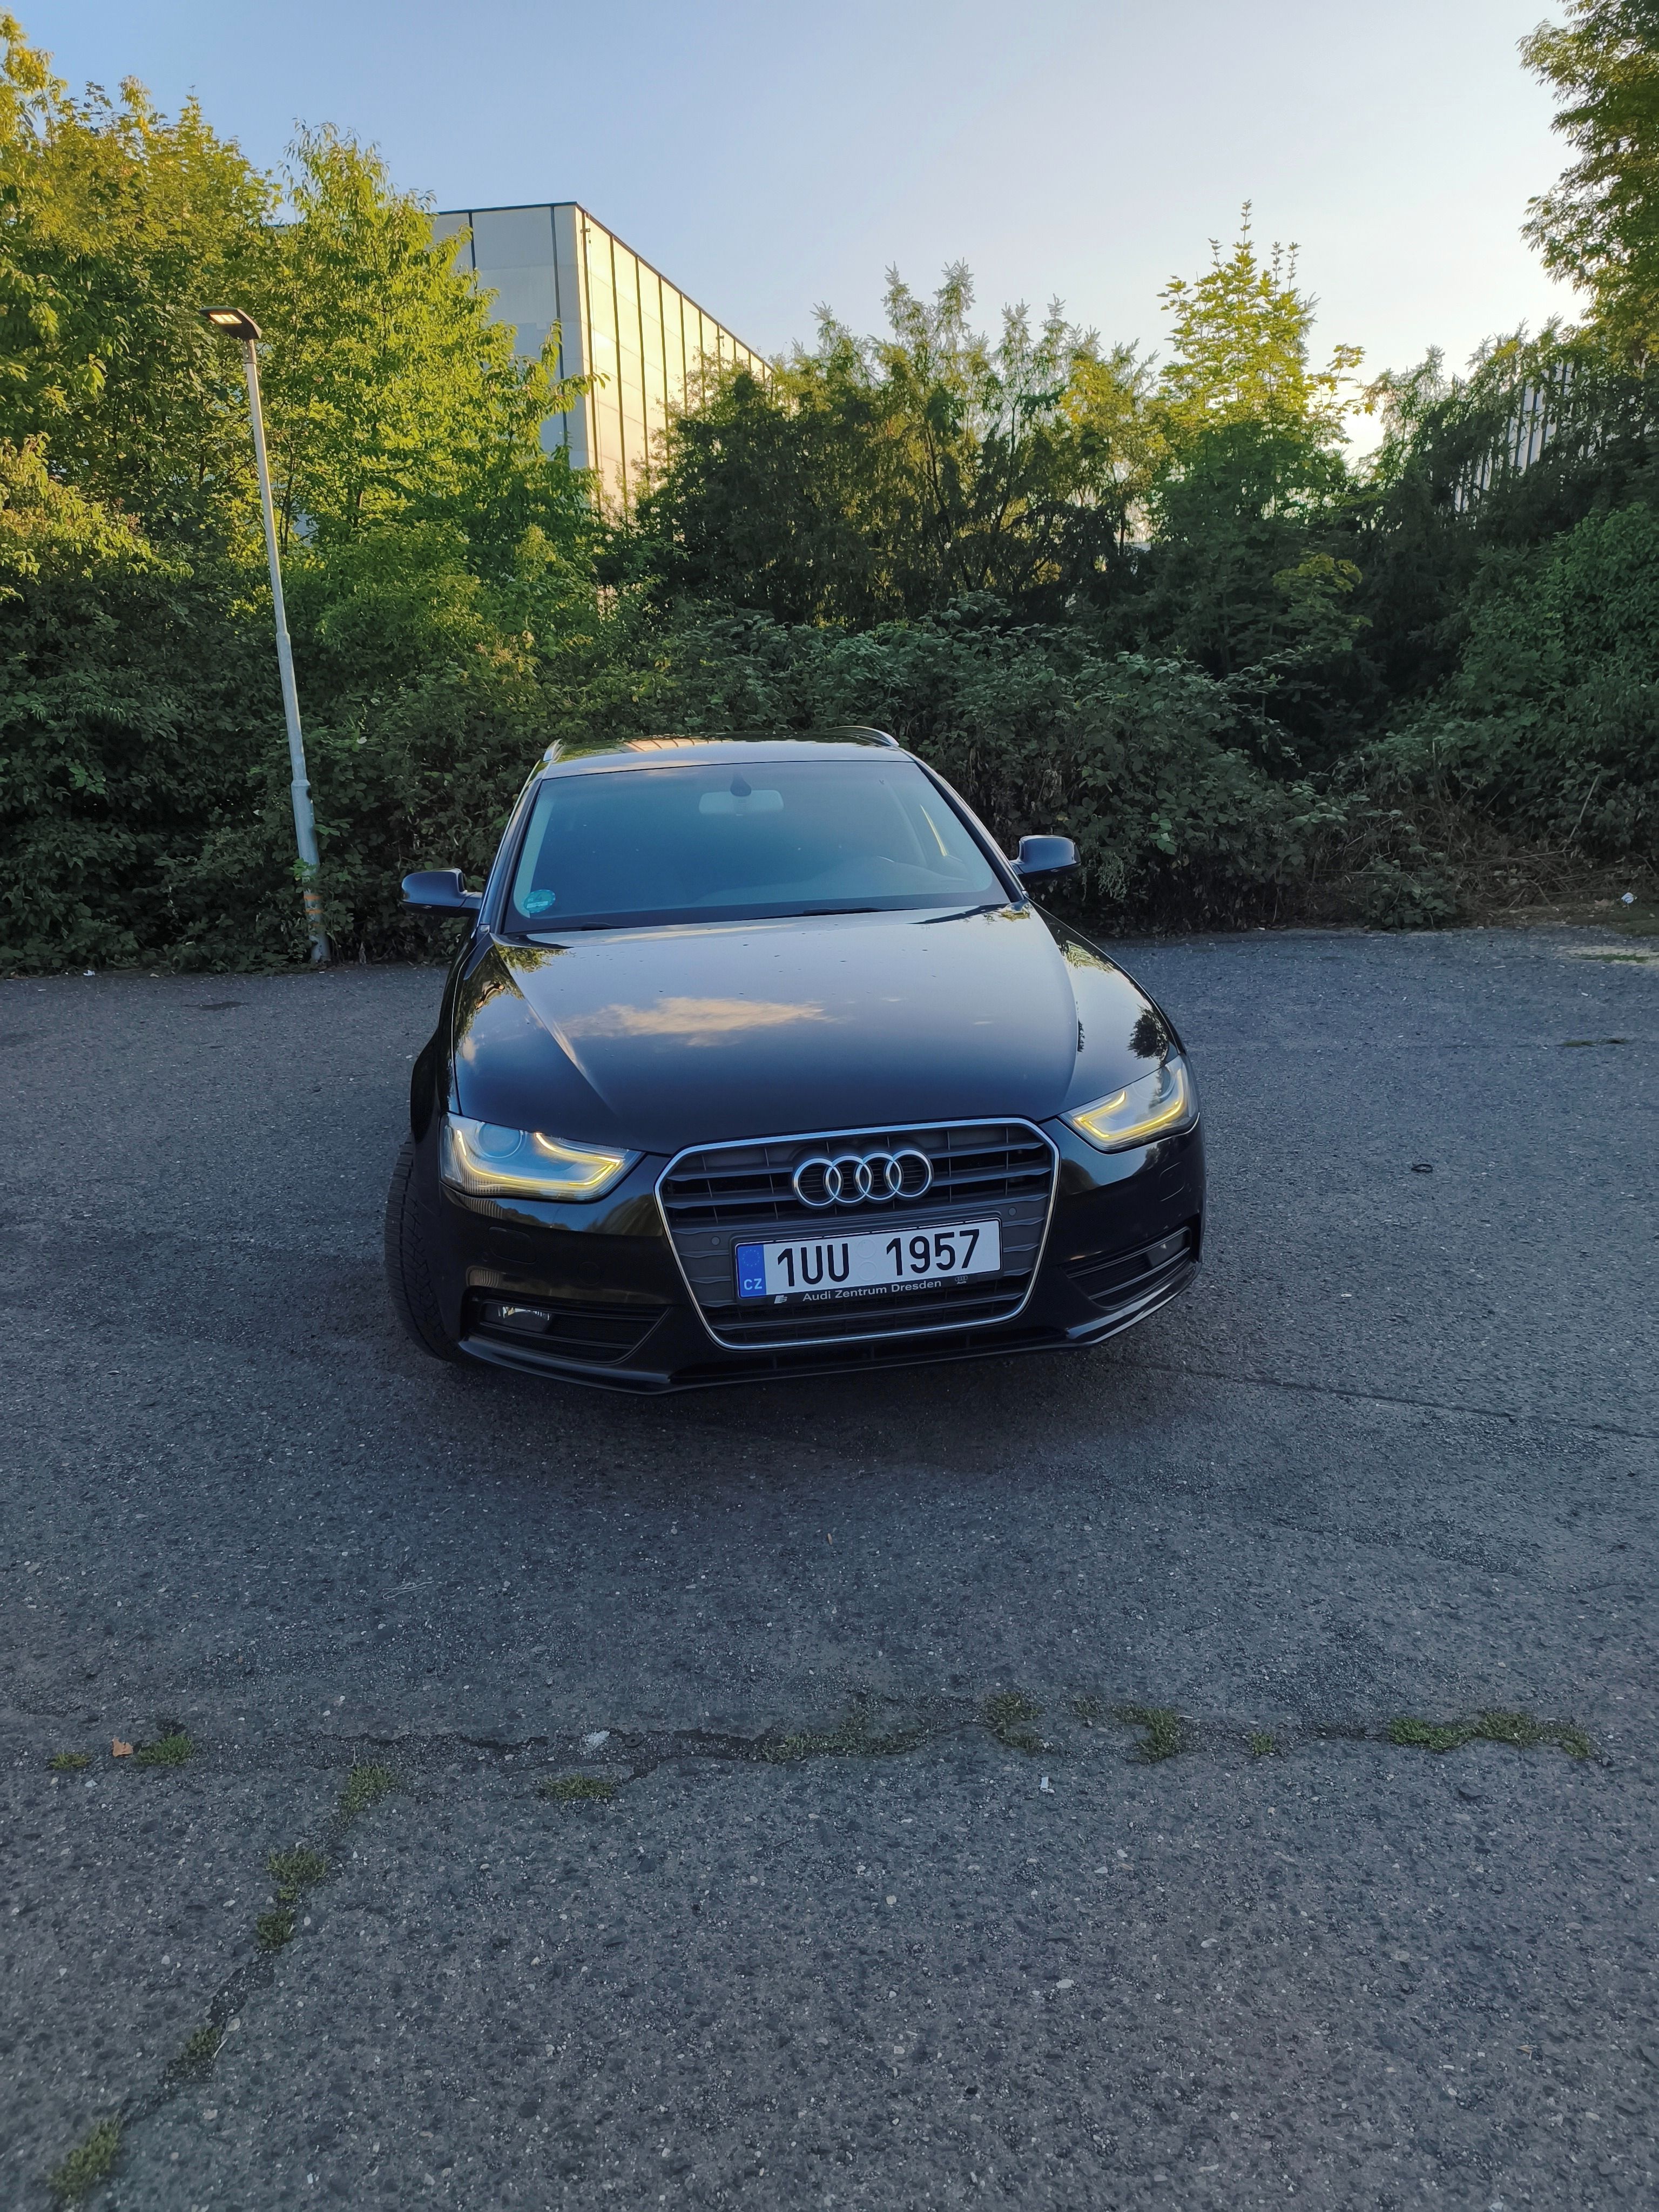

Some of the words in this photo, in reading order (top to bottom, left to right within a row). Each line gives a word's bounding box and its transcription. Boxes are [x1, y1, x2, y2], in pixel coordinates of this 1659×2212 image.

[778, 1243, 849, 1286] 1UU
[886, 1229, 980, 1276] 1957
[744, 1278, 763, 1290] CZ
[802, 1291, 831, 1301] Audi
[835, 1287, 887, 1298] Zentrum
[891, 1280, 941, 1292] Dresden
